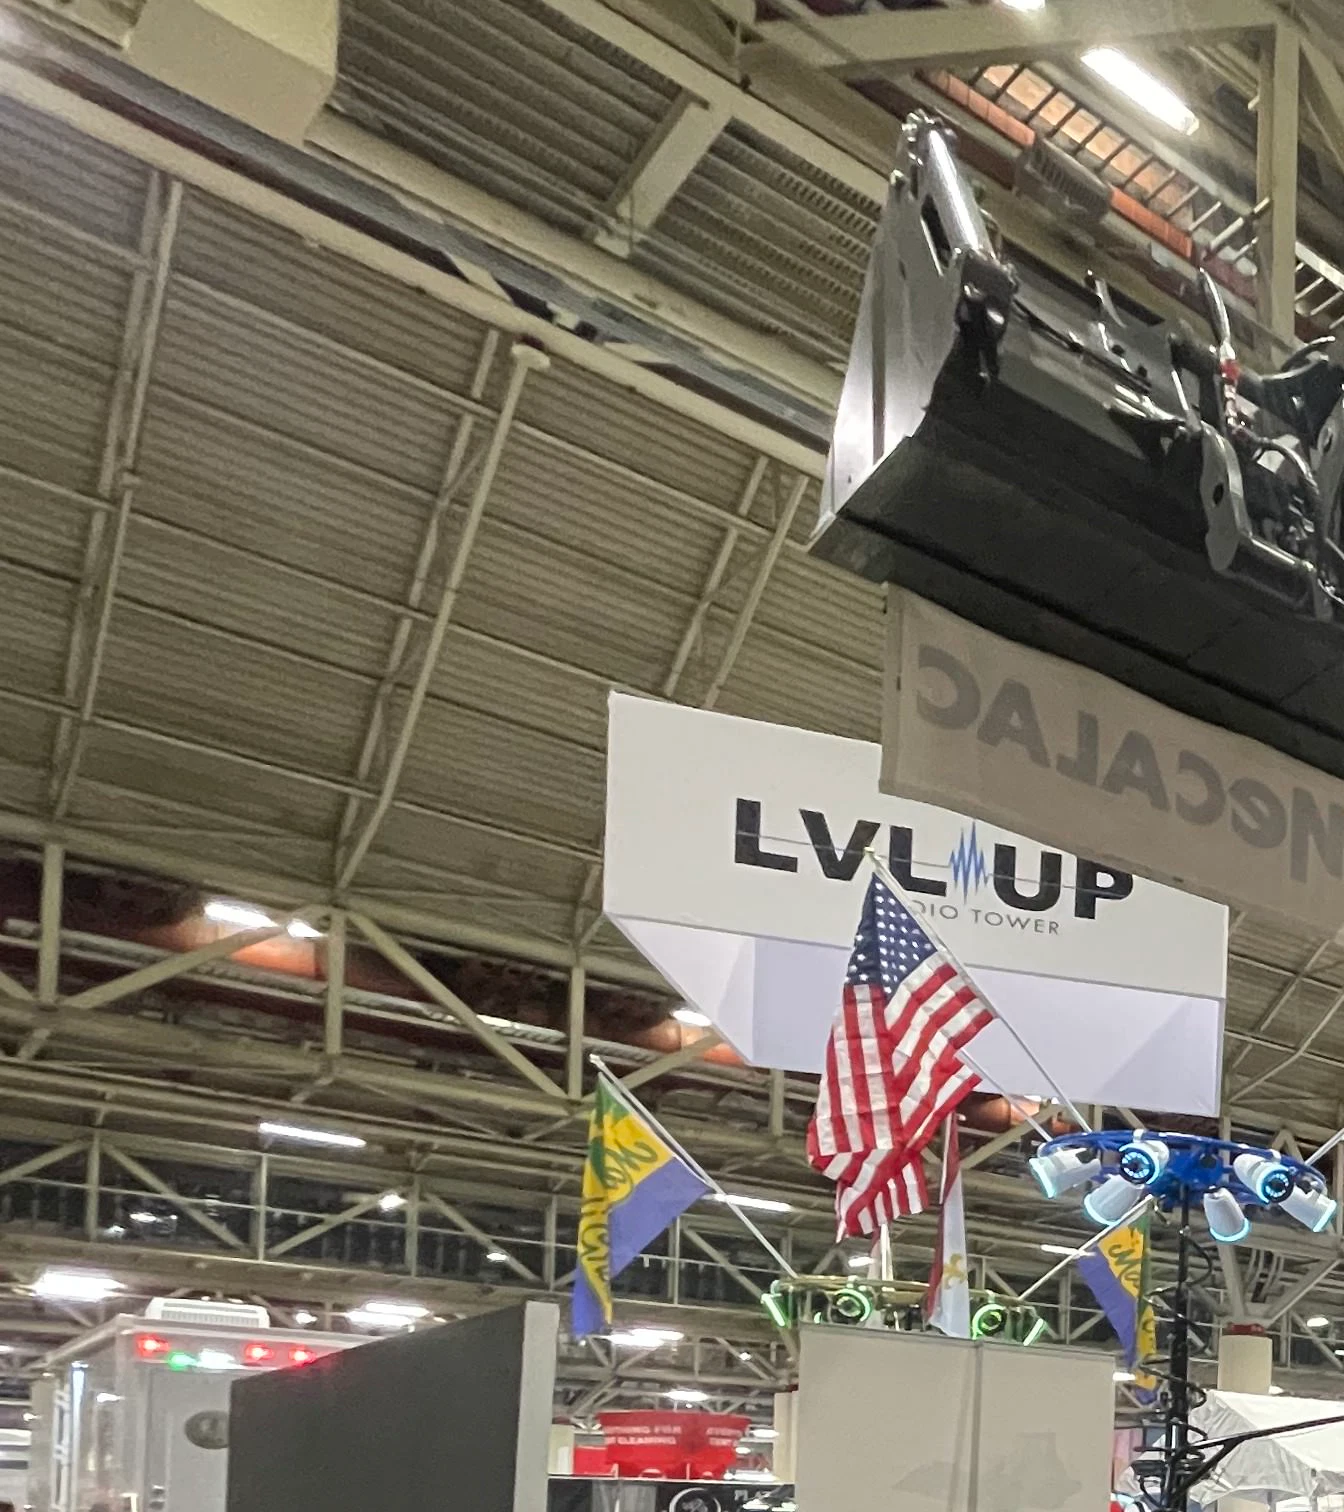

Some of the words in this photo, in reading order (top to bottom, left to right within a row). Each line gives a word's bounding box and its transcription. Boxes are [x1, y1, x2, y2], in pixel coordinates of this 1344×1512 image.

[735, 798, 946, 896] LVL
[993, 843, 1134, 919] UP
[971, 909, 1059, 935] TOWER
